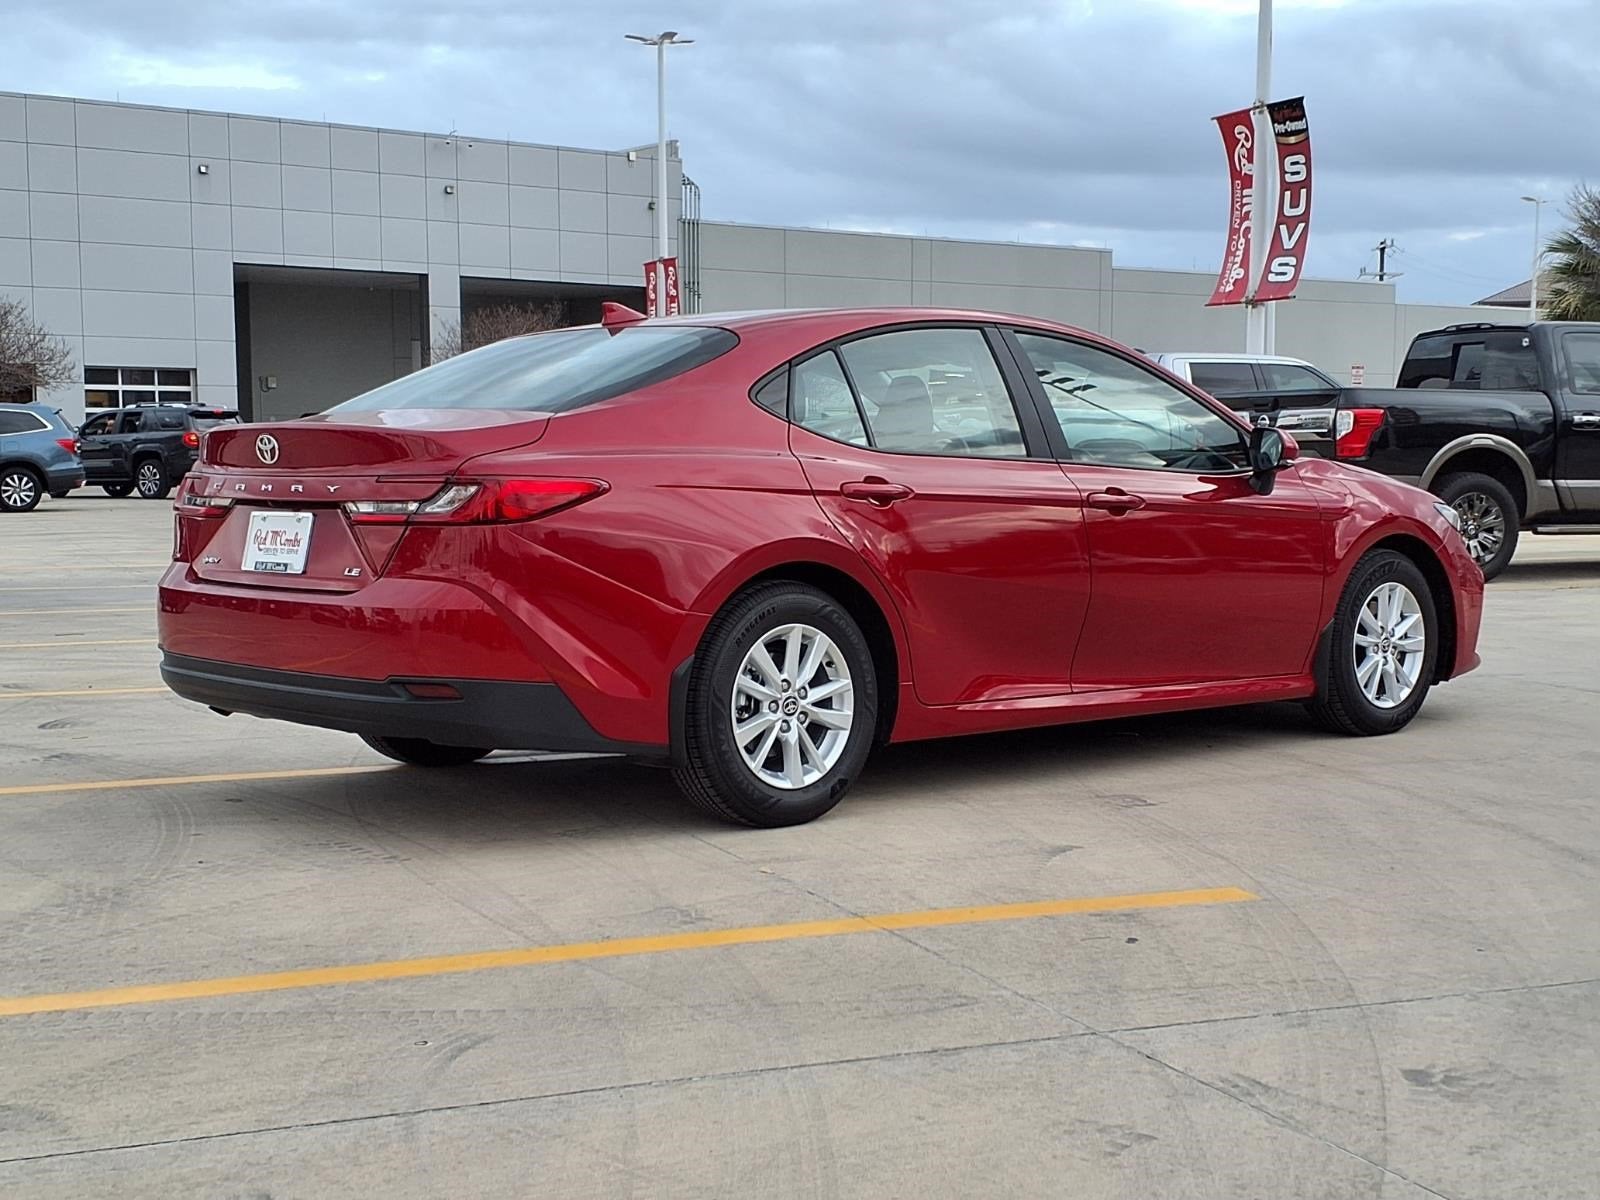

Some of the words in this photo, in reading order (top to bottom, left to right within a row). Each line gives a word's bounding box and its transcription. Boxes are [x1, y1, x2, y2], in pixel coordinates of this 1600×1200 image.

[1234, 125, 1253, 176] Red
[1232, 181, 1241, 229] DRIVEN
[1269, 155, 1307, 282] SUVS
[1230, 234, 1239, 251] TO
[667, 266, 677, 296] Red
[1219, 255, 1234, 293] SERVE
[213, 483, 341, 493] CAMRY
[254, 529, 269, 551] Red
[270, 530, 303, 547] McCombs
[344, 568, 361, 576] LE
